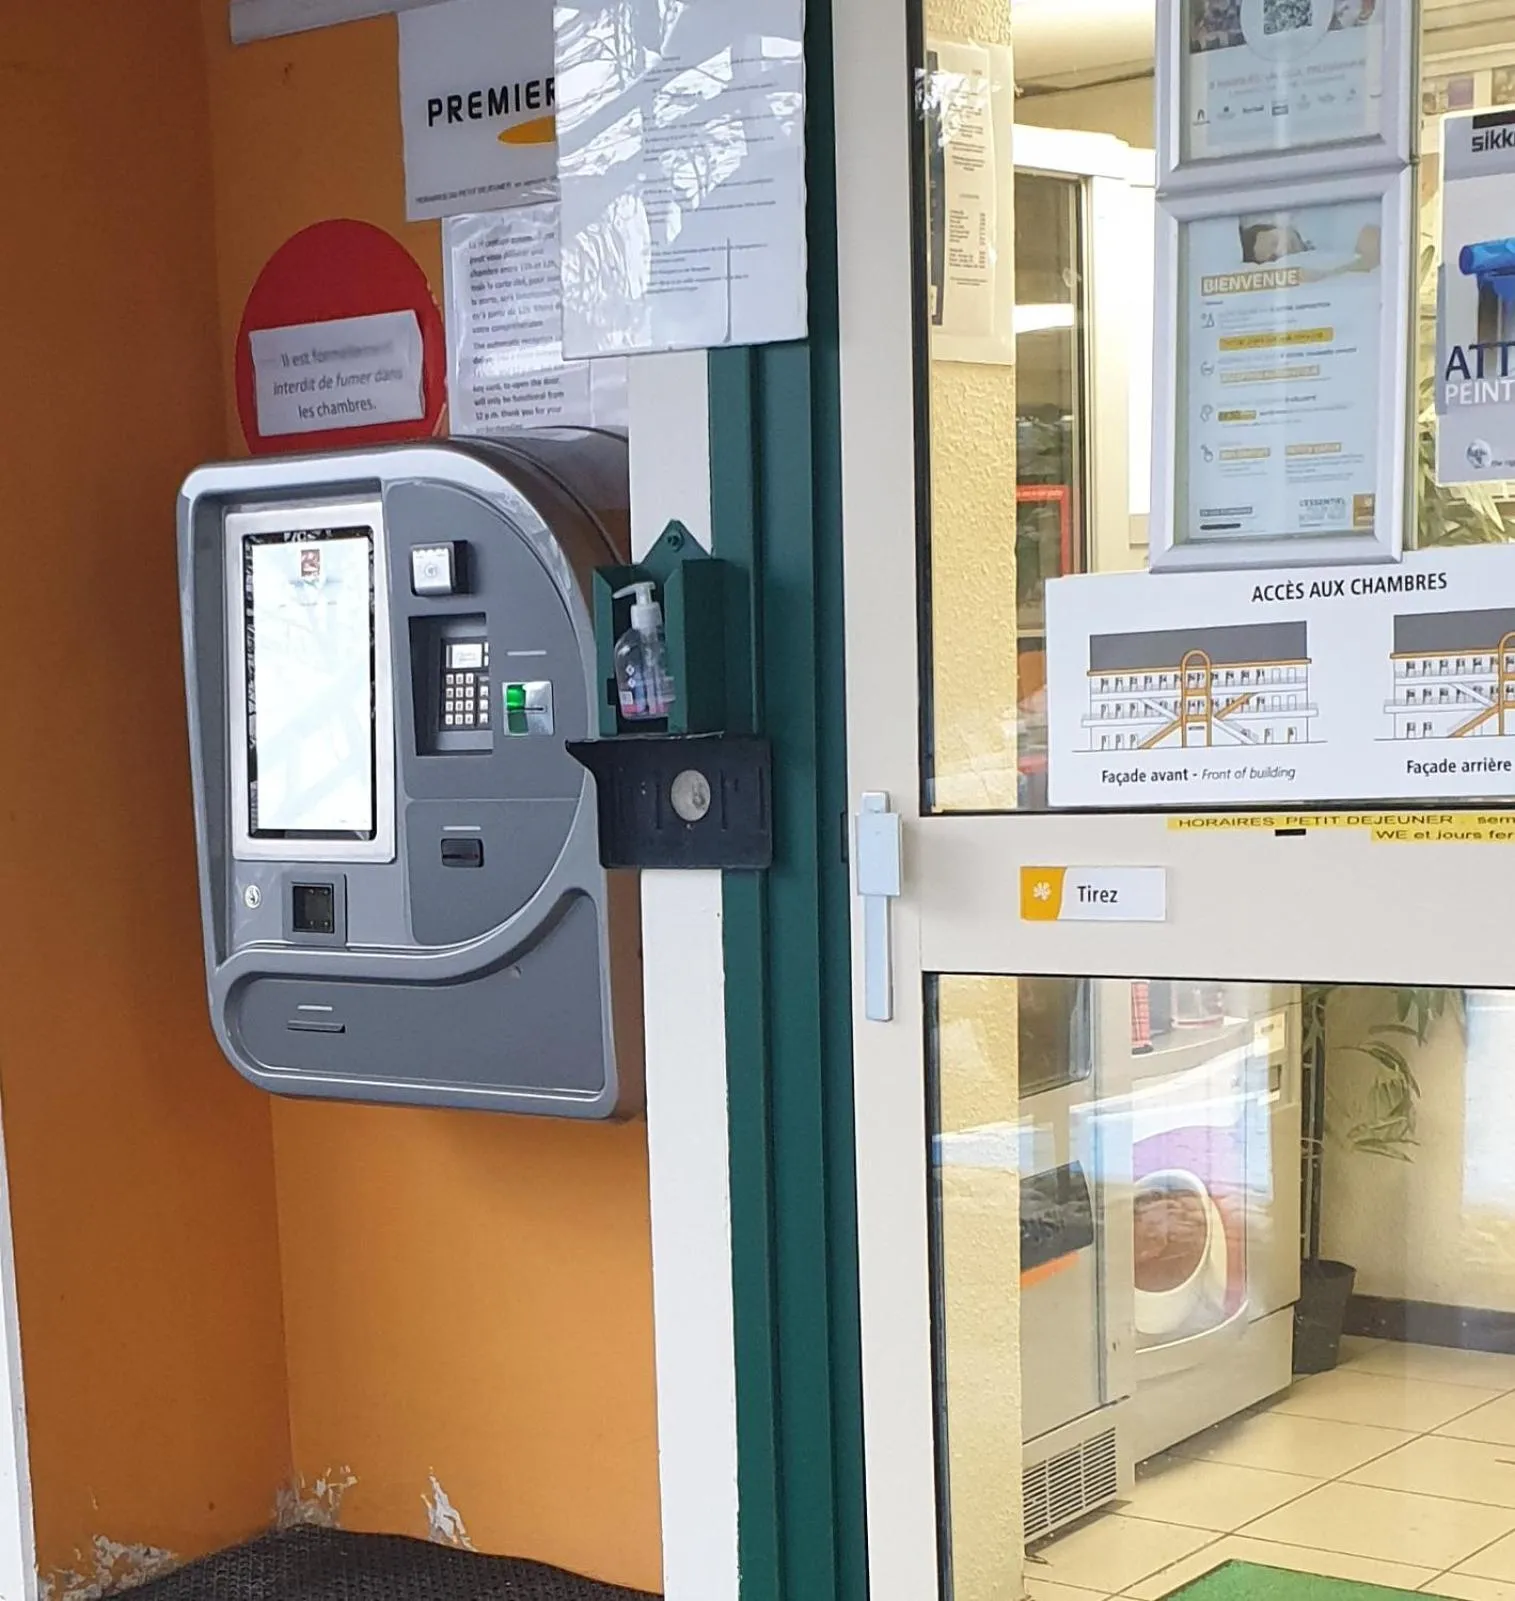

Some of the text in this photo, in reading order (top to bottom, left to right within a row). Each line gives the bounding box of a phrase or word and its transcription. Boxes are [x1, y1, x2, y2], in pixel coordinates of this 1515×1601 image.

[1472, 128, 1515, 152] sikk
[1203, 270, 1298, 294] BIENVENUE
[317, 373, 333, 390] de
[336, 370, 372, 388] fumer
[1446, 380, 1515, 405] PEINT
[298, 396, 377, 419] les chambres.
[1252, 572, 1447, 602] ACCÈS AUX CHAMBRES
[1102, 768, 1146, 786] Façade
[1150, 768, 1189, 782] avant
[1201, 767, 1231, 780] Front
[1234, 766, 1247, 779] of
[1249, 766, 1296, 781] building
[1406, 756, 1512, 777] Façade arrière
[1179, 817, 1276, 828] HORAIRES
[1286, 816, 1341, 826] PETIT
[1346, 815, 1454, 826] DEJEUNER
[1376, 829, 1408, 840] WE
[1413, 830, 1430, 840] et
[1437, 830, 1483, 841] jours
[1077, 885, 1119, 904] Tirez
